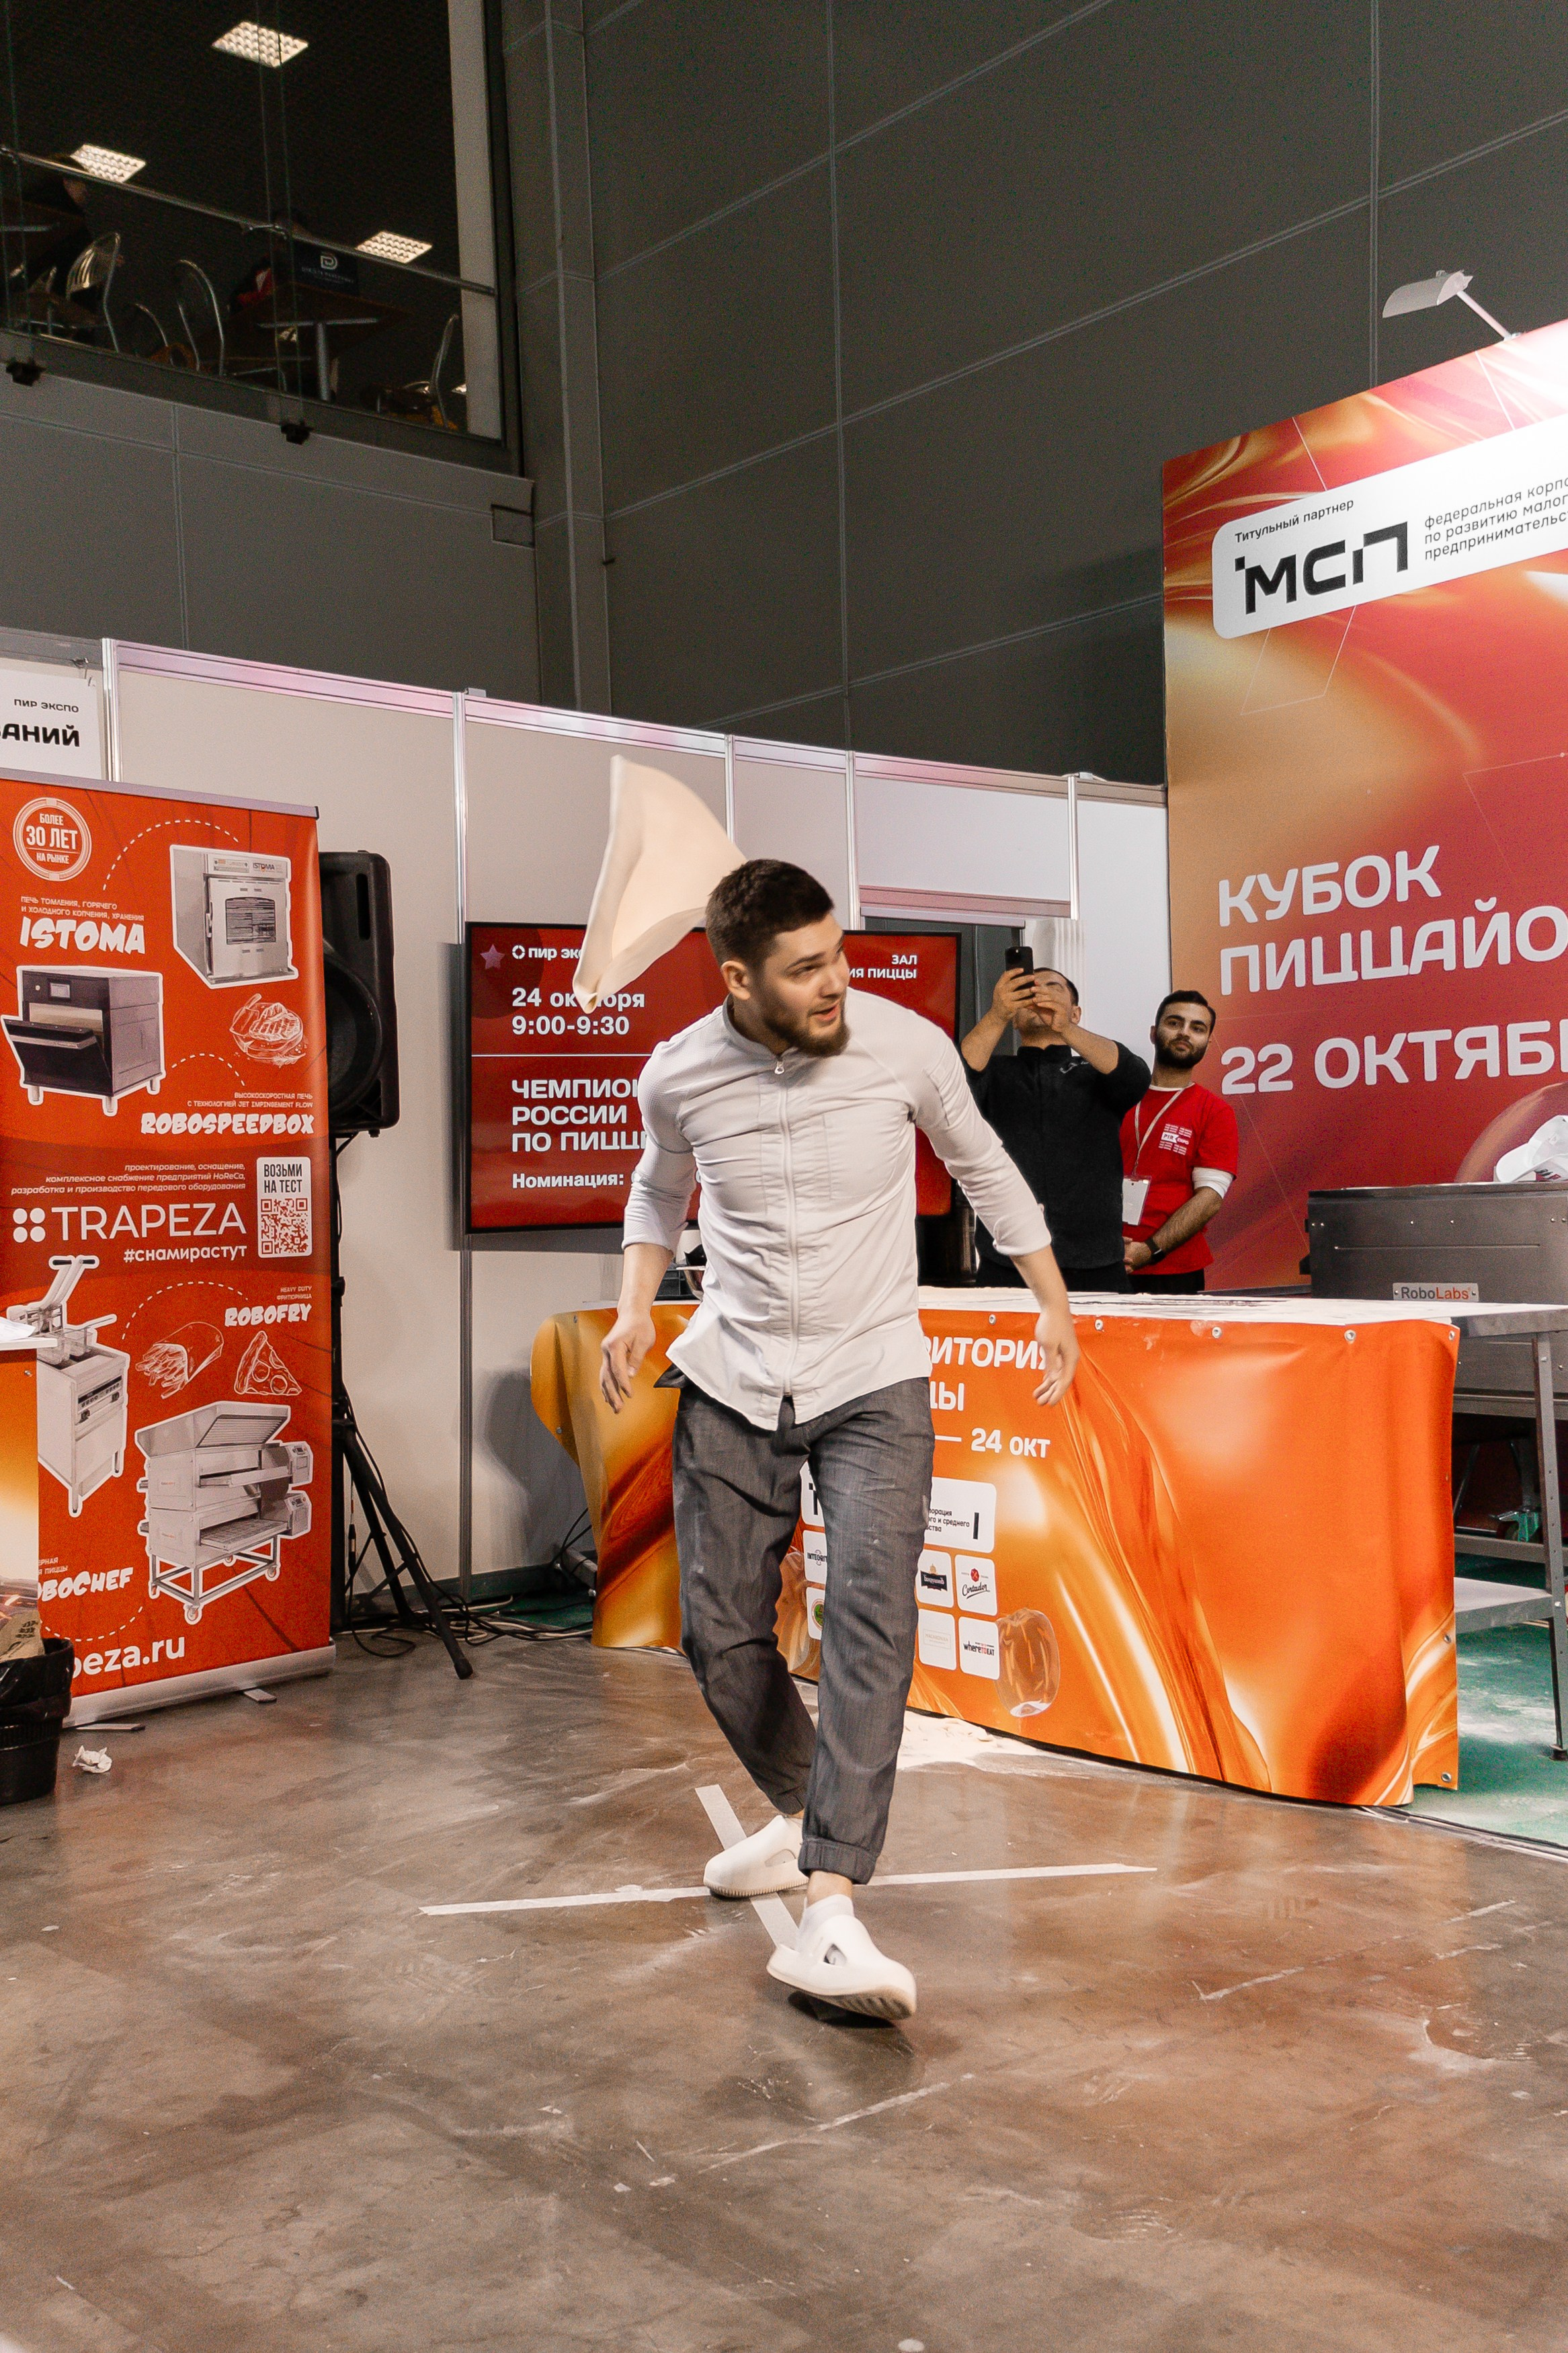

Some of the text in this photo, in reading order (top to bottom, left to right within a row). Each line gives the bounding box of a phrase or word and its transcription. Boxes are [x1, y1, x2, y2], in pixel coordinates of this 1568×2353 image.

[1424, 491, 1522, 530] федеральная
[1235, 500, 1354, 543] Титульный партнер
[1425, 532, 1441, 545] по
[1446, 510, 1517, 542] развитию
[13, 699, 79, 713] ПИР ЭКСПО
[0, 723, 80, 748] АНИЙ
[39, 813, 65, 826] БОЛЕЕ
[26, 825, 79, 850] 30 ЛЕТ
[36, 852, 70, 865] НА РЫНКЕ
[1219, 845, 1442, 927] КУБОК
[21, 895, 38, 904] ПЕЧЬ
[82, 901, 118, 910] ГОРЯЧЕГО
[29, 906, 71, 916] ХОЛОДНОГО
[112, 913, 145, 921] ХРАНЕНИЯ
[19, 916, 146, 955] ISTOMA
[1221, 897, 1568, 996] ПИЦЦАЙО
[891, 955, 917, 965] ЗАЛ
[867, 968, 917, 981] ПИЦЦЫ
[512, 987, 542, 1007] 24
[512, 1015, 630, 1035] 9:00-9:30
[1221, 1019, 1568, 1095] 22 ОКТЯБ
[194, 1100, 236, 1108] ТЕХНОЛОГИЕЙ
[140, 1112, 315, 1135] ROBOSPEEDBOX
[512, 1105, 627, 1126] РОССИИ
[512, 1132, 552, 1152] ПО
[124, 1163, 246, 1172] проектирование, оснащение,
[263, 1163, 302, 1177] ВОЗЬМИ
[46, 1175, 106, 1183] комплексное
[108, 1173, 155, 1182] снабжение
[157, 1172, 212, 1183] предприятий
[264, 1179, 302, 1193] НА ТЕСТ
[513, 1172, 624, 1189] Номинация:
[11, 1185, 65, 1195] разработка
[75, 1185, 136, 1194] производство
[137, 1184, 187, 1193] передового
[188, 1183, 246, 1192] оборудования
[51, 1202, 247, 1241] TRAPEZA
[123, 1245, 247, 1263] #снамирастут
[224, 1303, 313, 1328] ROBOFRY
[971, 1427, 1002, 1453] 24
[942, 1518, 970, 1527] среднего
[44, 1566, 69, 1574] ПИЦЦЫ
